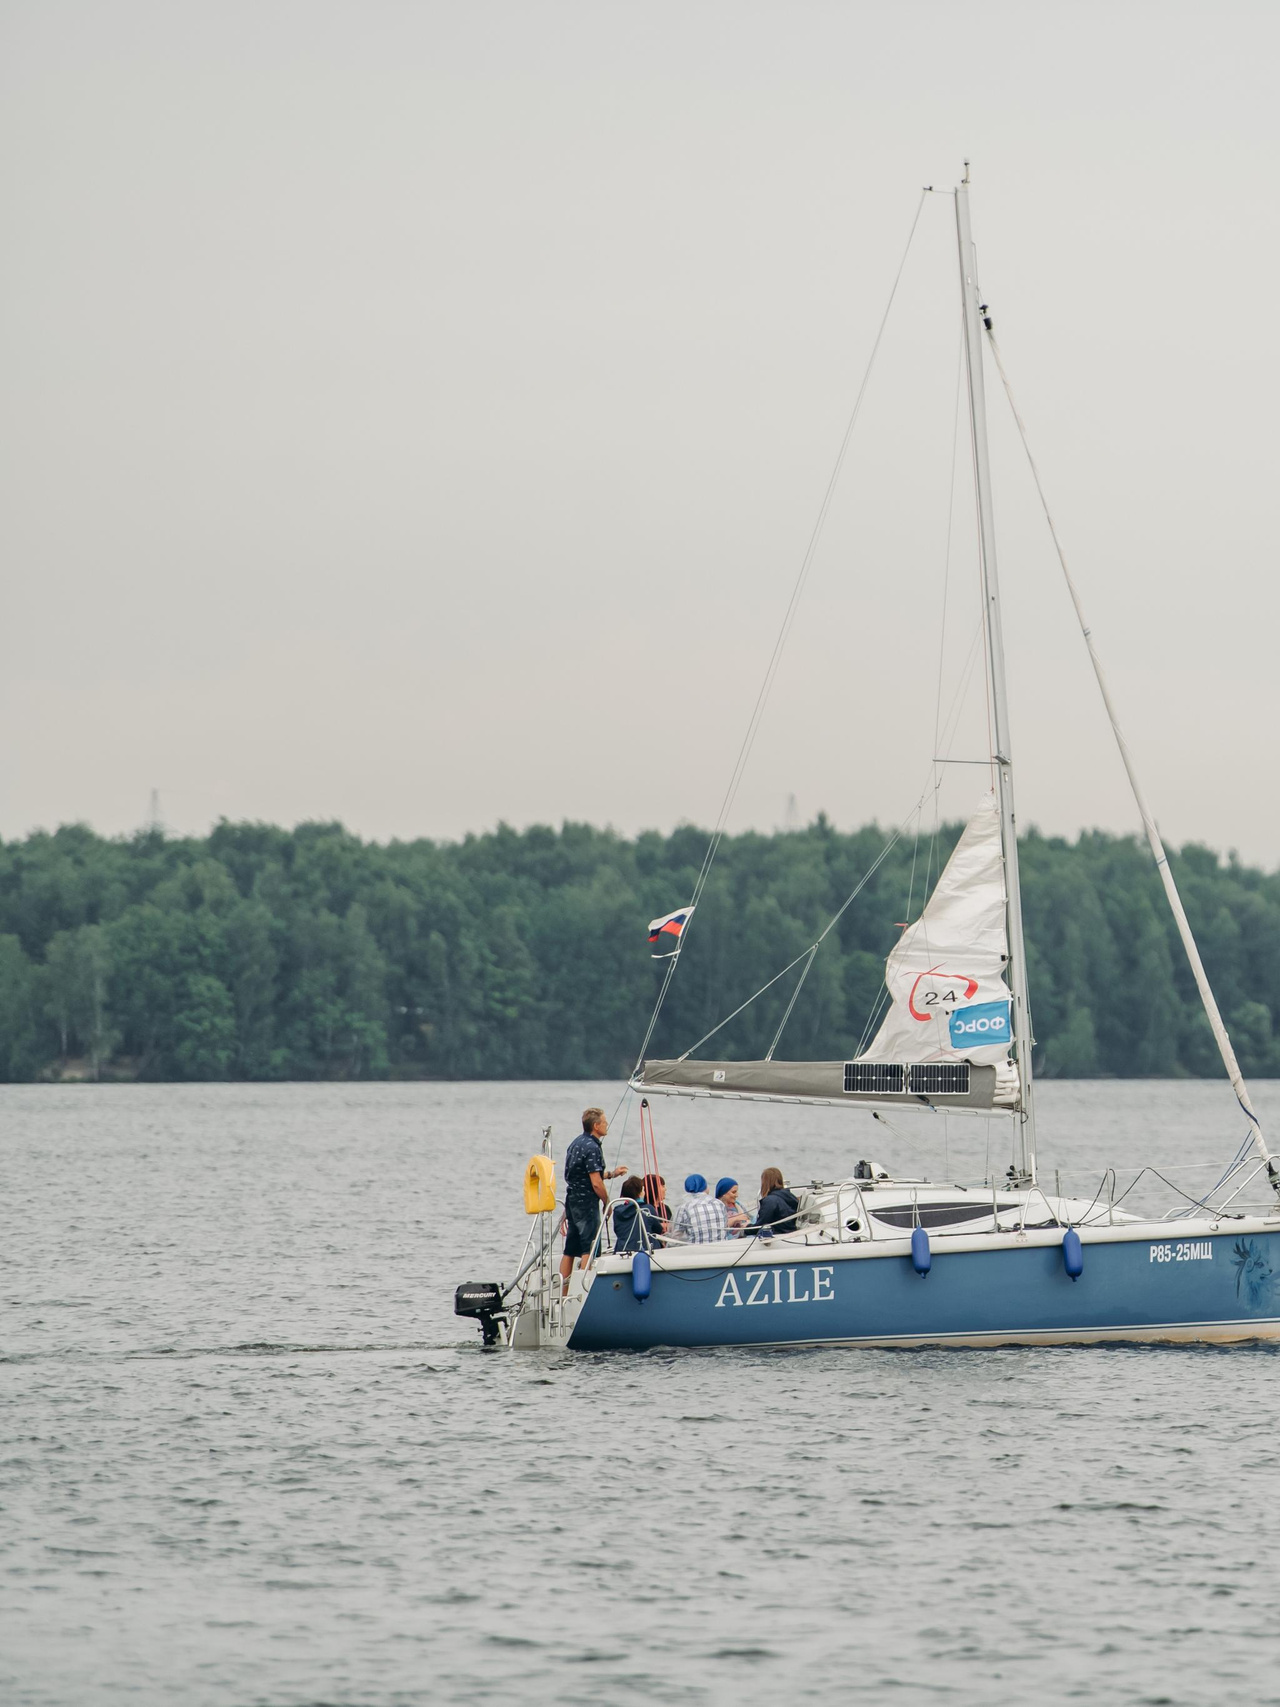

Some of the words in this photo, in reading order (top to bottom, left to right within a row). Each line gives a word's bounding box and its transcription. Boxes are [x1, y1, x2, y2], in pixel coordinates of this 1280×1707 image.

[924, 989, 959, 1006] 24
[953, 1016, 1006, 1035] ФОРС
[1149, 1241, 1213, 1263] Р85-25МЩ
[714, 1266, 835, 1307] AZILE
